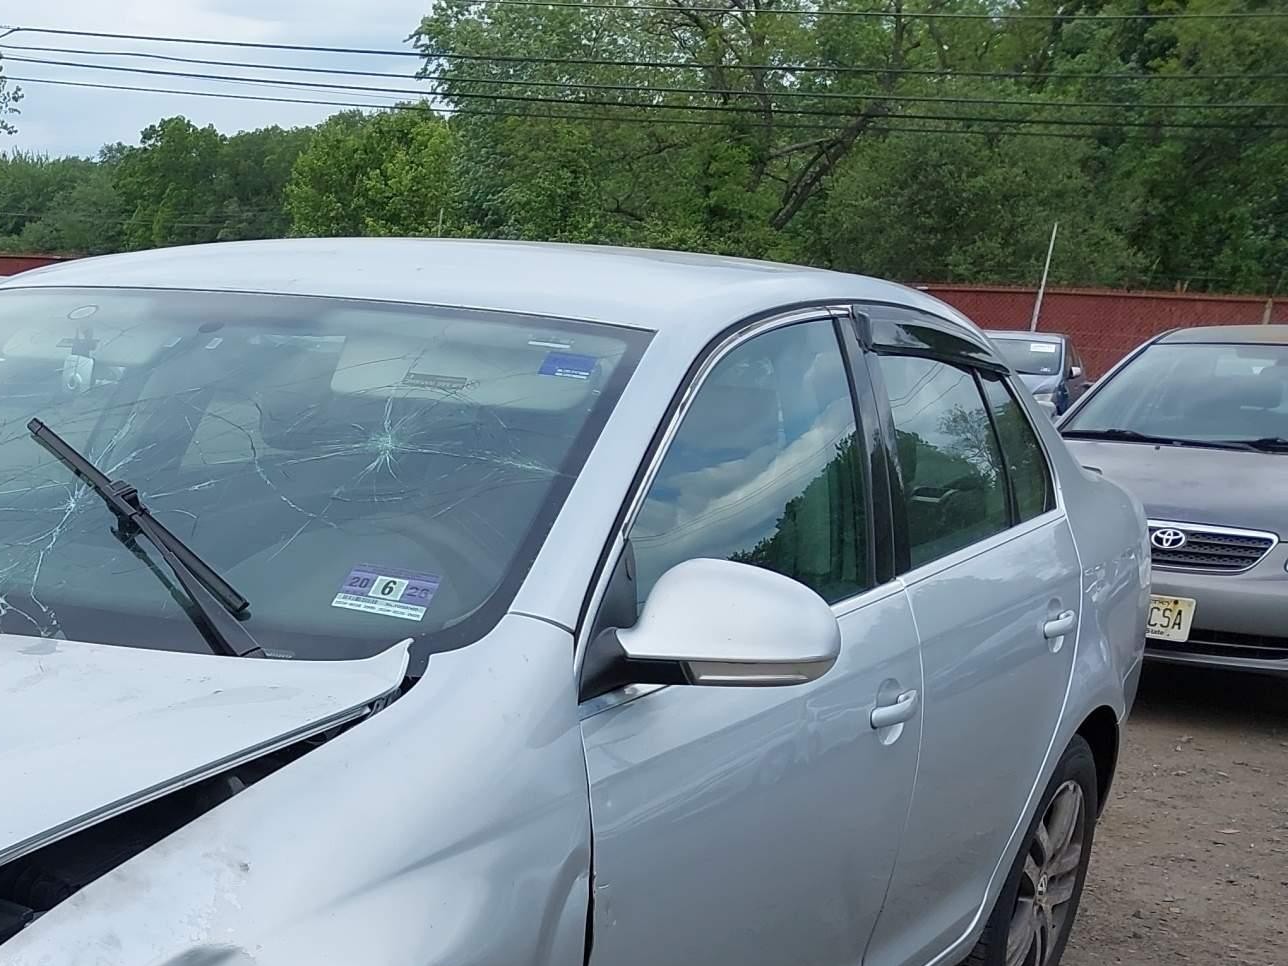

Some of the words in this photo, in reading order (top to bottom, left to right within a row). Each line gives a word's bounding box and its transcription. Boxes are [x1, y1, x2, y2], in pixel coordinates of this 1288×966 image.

[348, 576, 370, 589] 20
[380, 579, 397, 596] 6
[1147, 606, 1182, 630] CSA
